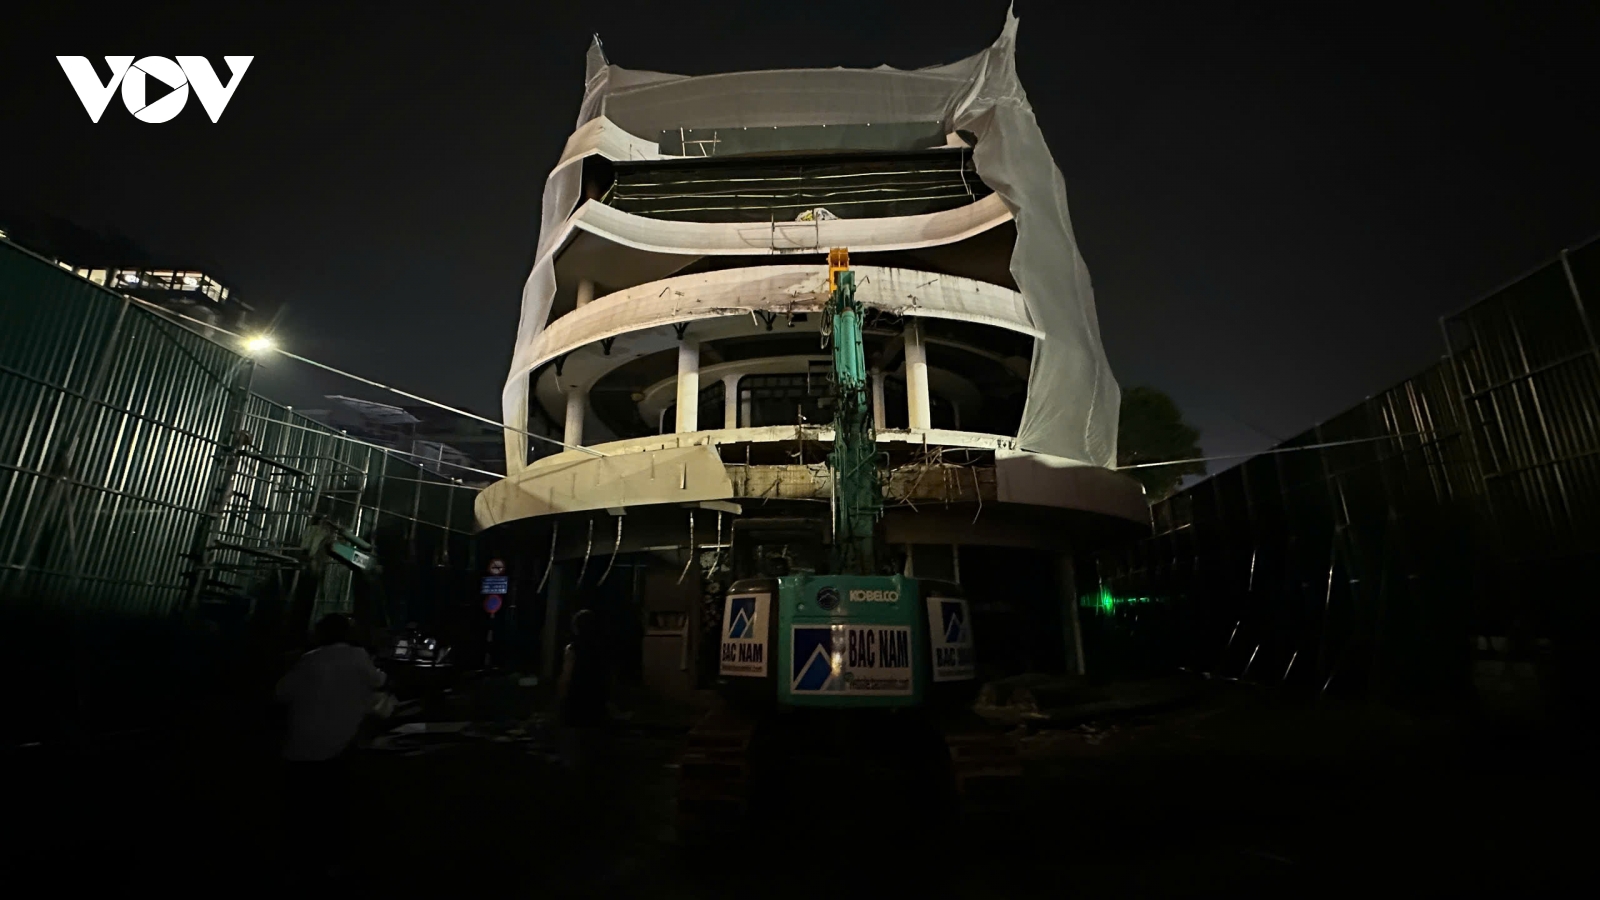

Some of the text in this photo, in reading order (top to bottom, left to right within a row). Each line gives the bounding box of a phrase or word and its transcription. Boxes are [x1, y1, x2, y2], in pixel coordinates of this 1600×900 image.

[849, 589, 899, 602] KOBELCO
[722, 643, 763, 663] BAC NAM
[848, 629, 909, 668] BAC NAM
